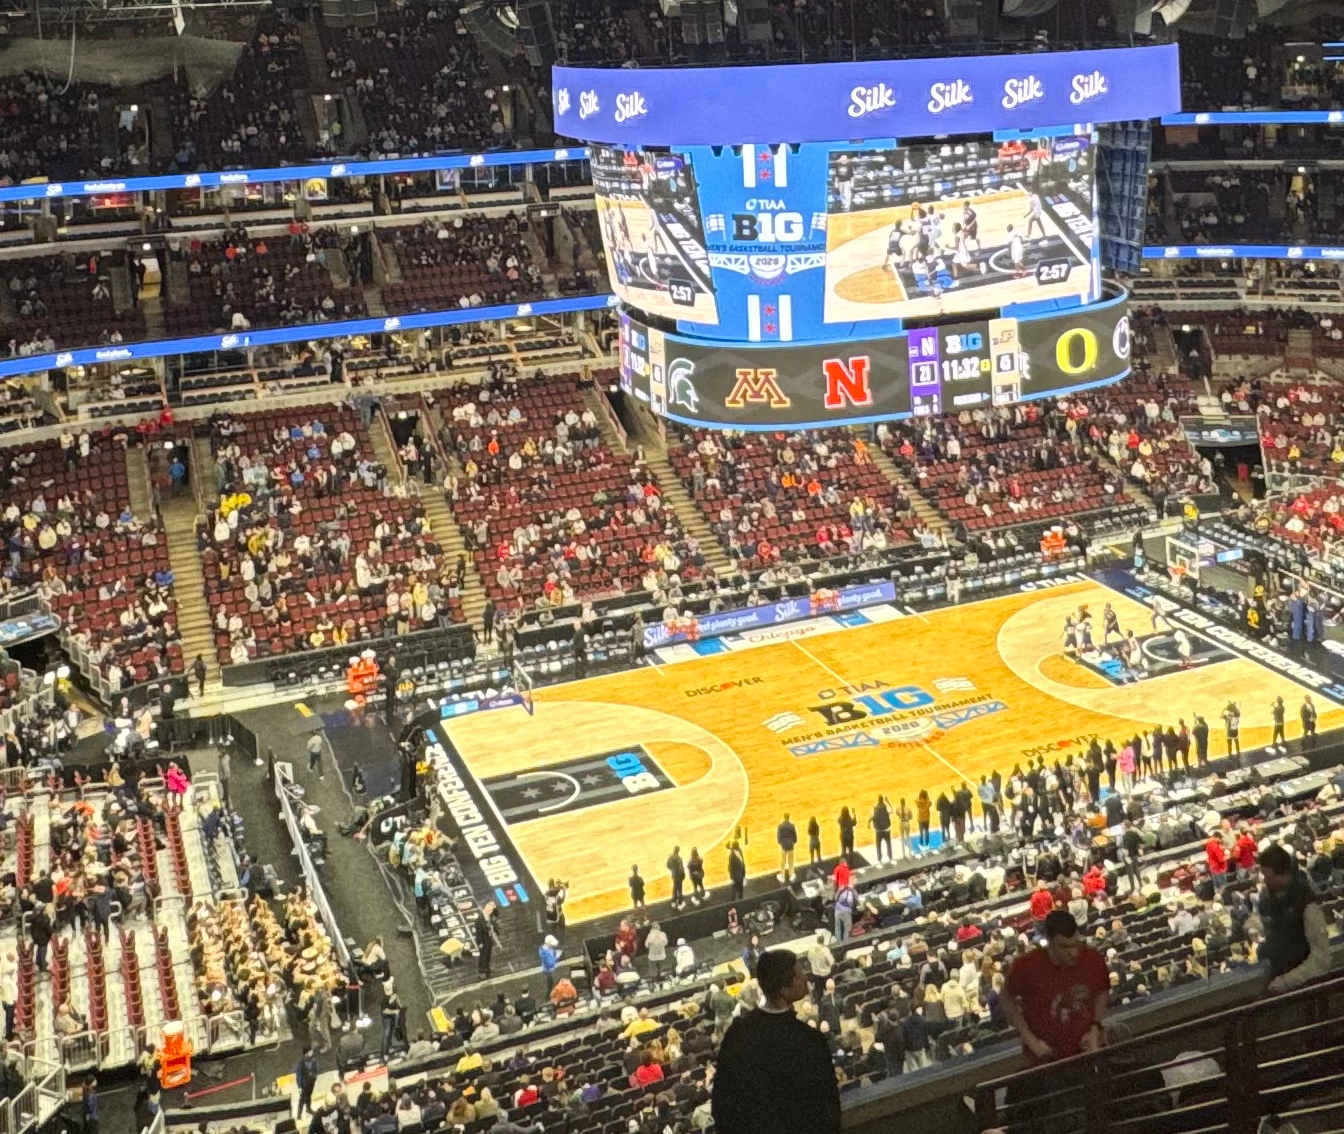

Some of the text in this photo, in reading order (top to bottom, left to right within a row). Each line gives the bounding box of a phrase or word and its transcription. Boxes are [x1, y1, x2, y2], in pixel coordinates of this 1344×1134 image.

[848, 82, 896, 117] Silk
[927, 79, 973, 114] Silk
[1001, 74, 1043, 109] Silk
[1069, 70, 1108, 104] Silk
[557, 88, 571, 116] Silk
[579, 89, 600, 120] Silk
[614, 91, 647, 123] Silk
[757, 199, 787, 210] TIAA
[728, 244, 778, 253] BASKETBALL
[1039, 264, 1068, 280] 2:57
[920, 336, 936, 357] N
[1055, 327, 1098, 374] O
[822, 355, 873, 410] N
[919, 365, 932, 382] 21
[942, 356, 980, 381] 11:32
[725, 368, 791, 408] M
[711, 617, 737, 631] plenty
[774, 599, 800, 622] Silk
[643, 624, 669, 648] Silk
[748, 625, 817, 644] Chicago
[1173, 608, 1214, 629] TEN
[1206, 625, 1332, 688] CONFERENCE
[684, 676, 765, 698] DISCOVER
[840, 679, 891, 696] TIAA
[781, 692, 994, 746] MEN'S BASKETBALL TOURNAMENT
[461, 824, 500, 858] TEN
[479, 855, 518, 886] BIG
